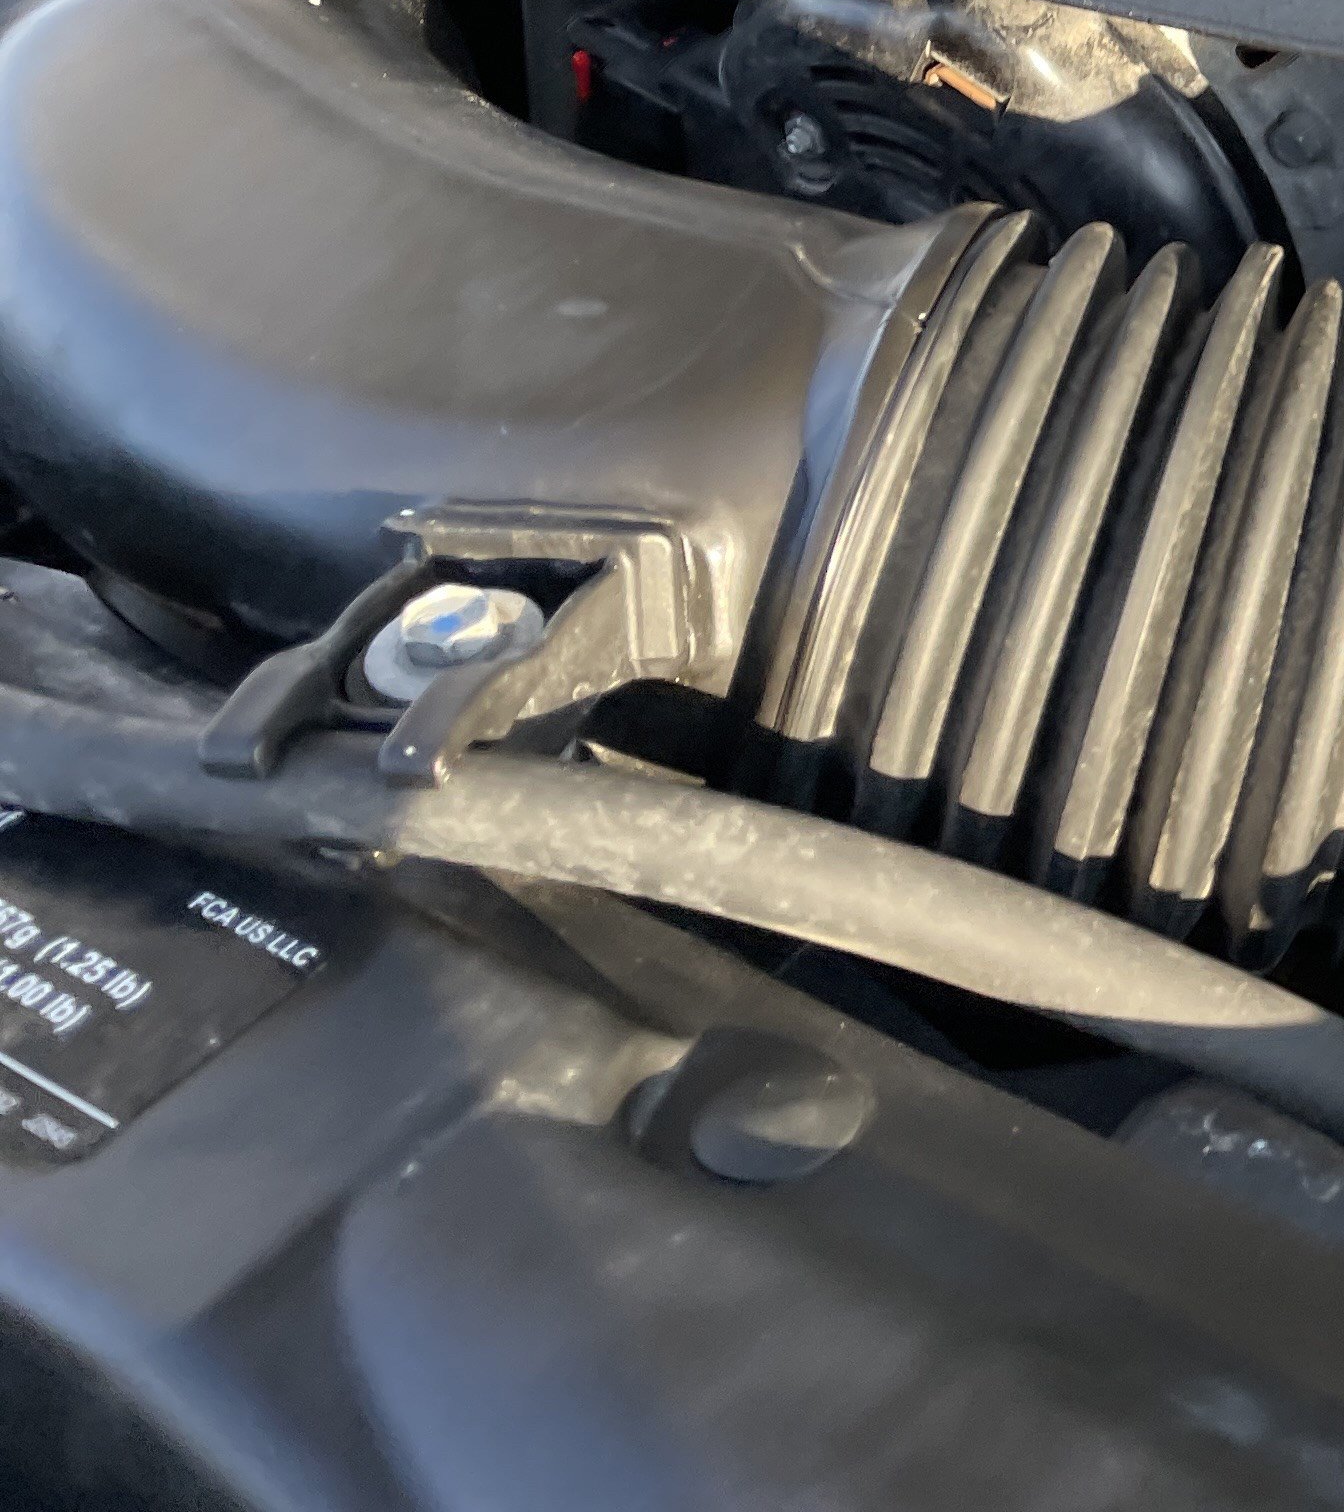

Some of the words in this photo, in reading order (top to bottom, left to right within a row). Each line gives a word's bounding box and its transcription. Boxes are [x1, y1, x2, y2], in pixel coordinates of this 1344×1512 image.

[186, 890, 240, 928] FCA
[233, 915, 275, 945] US
[265, 932, 320, 968] LLC
[0, 957, 55, 1007] 1.00
[38, 992, 93, 1034] lb)
[33, 935, 118, 984] (1.25
[100, 968, 153, 1010] lb)
